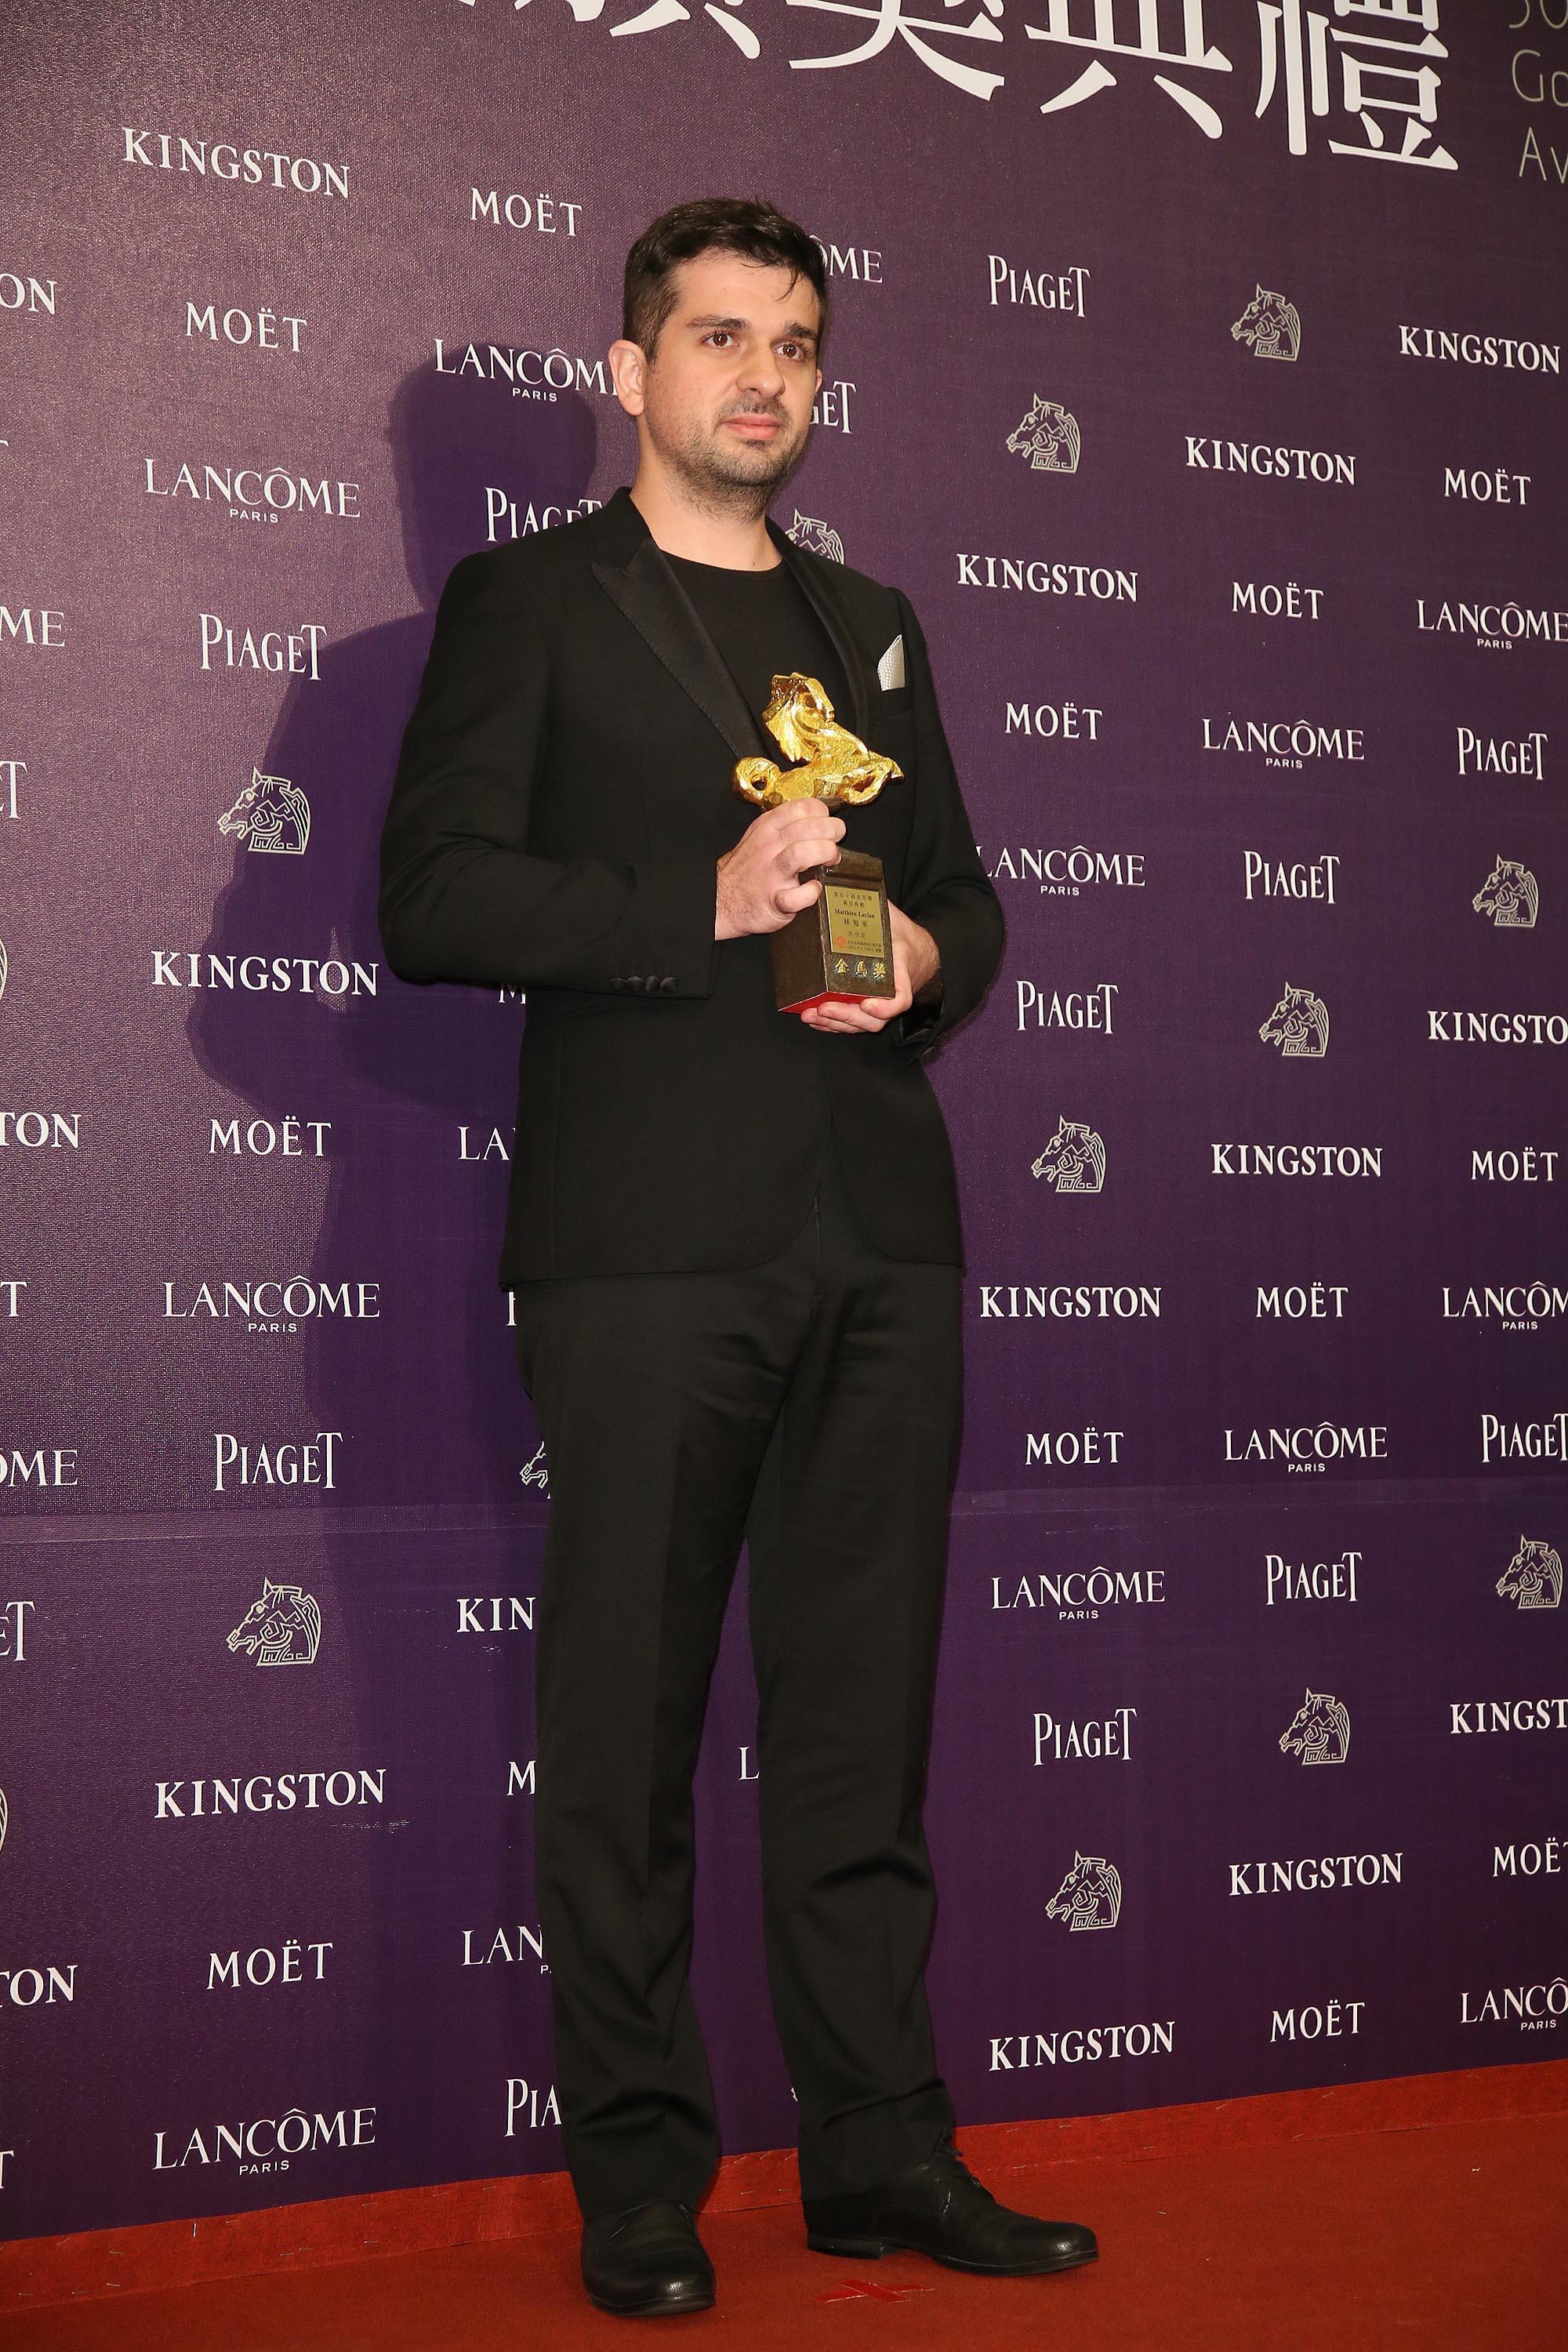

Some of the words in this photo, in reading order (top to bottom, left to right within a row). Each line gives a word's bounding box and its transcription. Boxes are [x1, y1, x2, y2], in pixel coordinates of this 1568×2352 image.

[122, 127, 350, 198] KINGSTON
[471, 187, 582, 237] MOËT
[988, 254, 1091, 318] PIAGET
[186, 302, 307, 352] MOËT
[434, 338, 616, 395] LANCÔM
[1399, 325, 1561, 374] KINGSTON
[513, 388, 557, 401] PARIS
[1185, 436, 1356, 485] KINGSTON
[145, 458, 360, 517] LANCÔME
[1444, 467, 1531, 505] MOËT
[230, 507, 279, 523] PARIS
[956, 553, 1138, 602] KINGSTON
[1232, 582, 1324, 619] MOËT
[199, 613, 326, 680] PIAGET
[1476, 638, 1512, 650] PARIS
[1004, 702, 1103, 740] MOËT
[1202, 718, 1365, 760] LANCÔME
[1265, 757, 1303, 769] PARIS
[1457, 727, 1548, 781] PIAGET
[1040, 884, 1080, 896] PARIS
[1243, 850, 1341, 905] PIAGET
[151, 950, 378, 996] KINGSTON
[1016, 980, 1119, 1035] PIAGET
[209, 1115, 332, 1156] MOËT
[1210, 1143, 1383, 1178] KINGSTON
[1471, 1146, 1559, 1181] MOËT
[163, 1275, 381, 1318] LANCÔME
[979, 1286, 1162, 1318] KINGSTON
[1256, 1281, 1349, 1318] MOËT
[248, 1323, 297, 1332] PARIS
[1502, 1320, 1538, 1330] PARIS
[214, 1432, 343, 1491] PIAGET
[1025, 1426, 1124, 1465] MOËT
[1225, 1421, 1388, 1461] LANCÔME
[1287, 1462, 1326, 1473] PARIS
[991, 1566, 1166, 1610] LANCÔME
[1265, 1552, 1363, 1606] PIAGET
[1058, 1610, 1099, 1621] PARIS
[1033, 1708, 1138, 1766] PIAGET
[154, 1769, 386, 1818] KINGSTON
[1229, 1852, 1403, 1896] KINGSTON
[206, 1939, 333, 1990] MOËT
[1270, 1998, 1366, 2042] MOËT
[1520, 2019, 1556, 2031] PARIS
[989, 2020, 1175, 2071] KINGSTON
[154, 2107, 376, 2170] LANCÔME
[239, 2159, 289, 2176] PARIS
